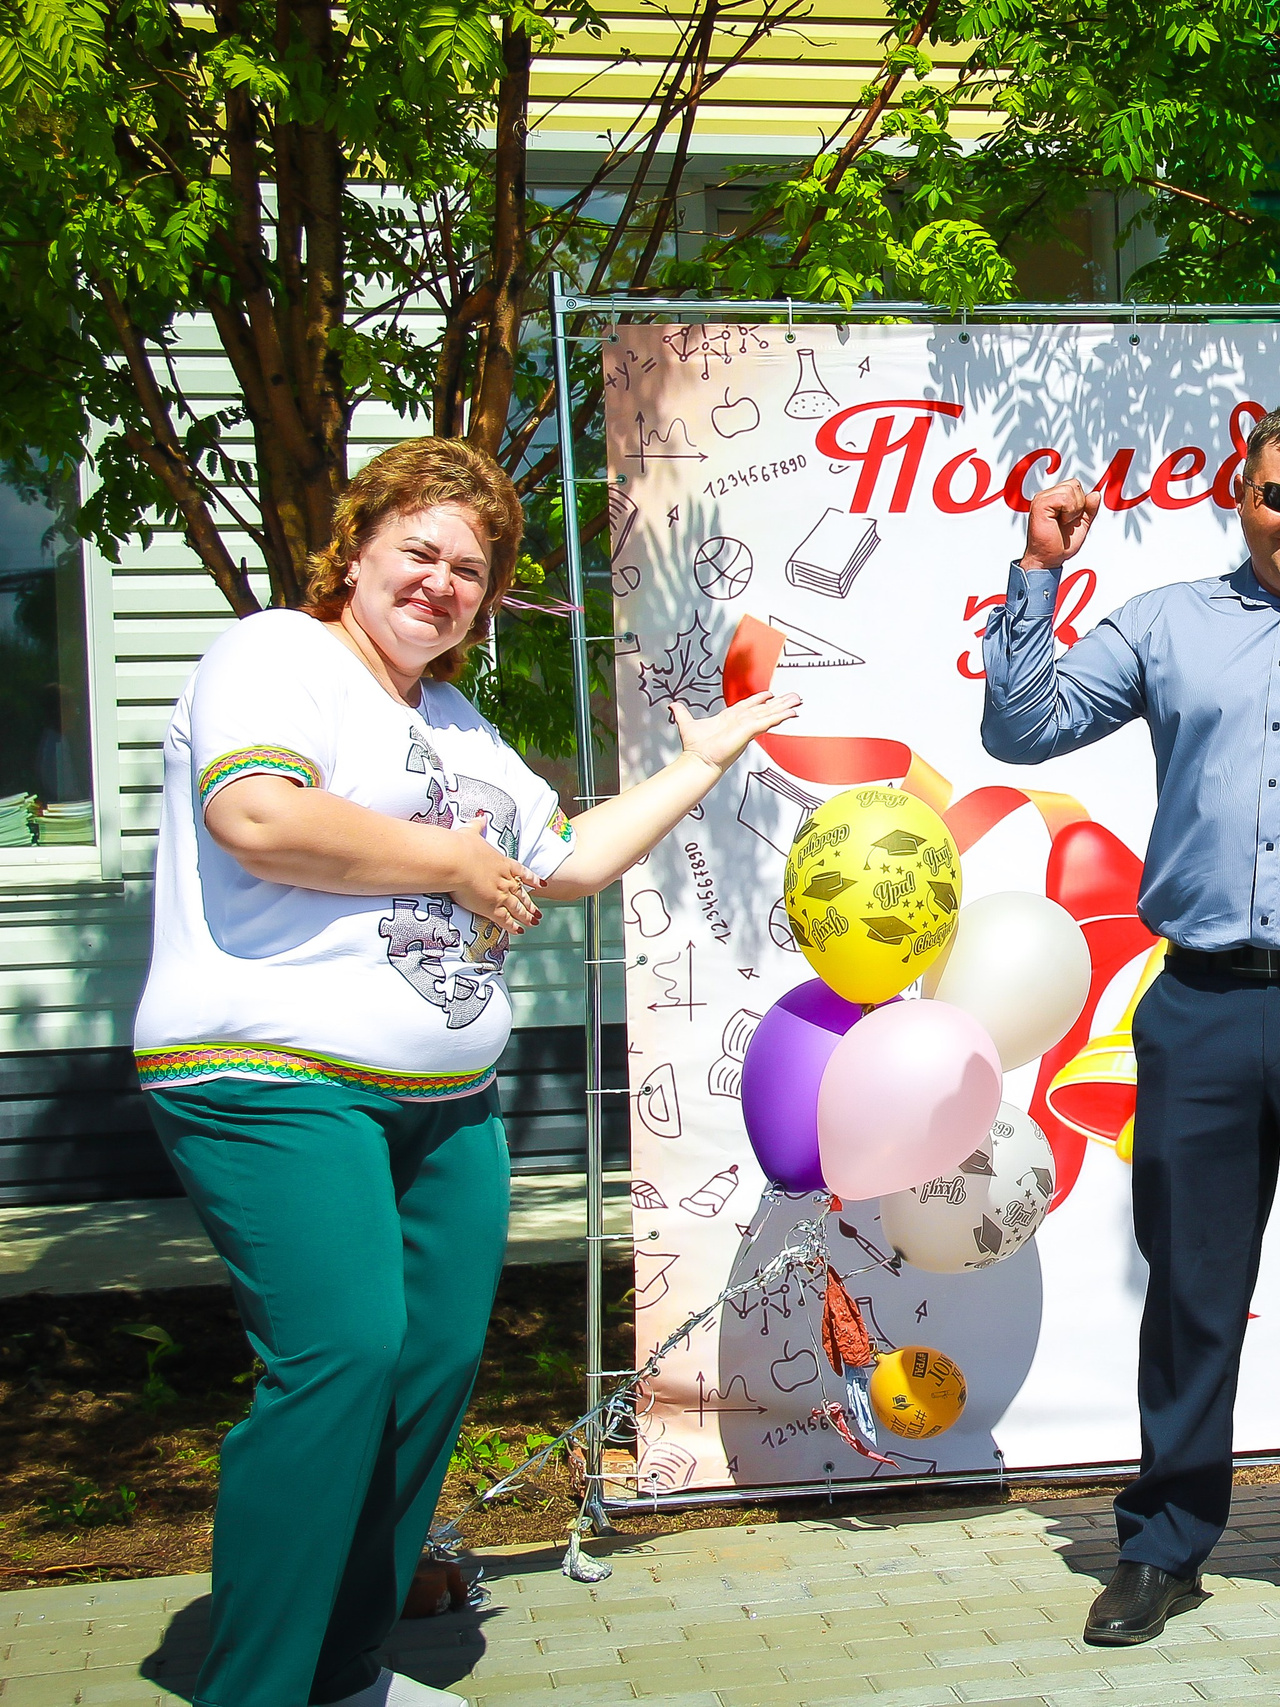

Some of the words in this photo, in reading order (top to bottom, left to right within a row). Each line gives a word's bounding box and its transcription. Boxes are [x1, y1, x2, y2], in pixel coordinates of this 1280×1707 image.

[703, 454, 808, 499] 1234567890
[684, 842, 734, 945] 1234567890
[873, 871, 916, 910] Ура!
[1002, 1200, 1038, 1227] Ура!
[927, 1353, 954, 1387] МОГ
